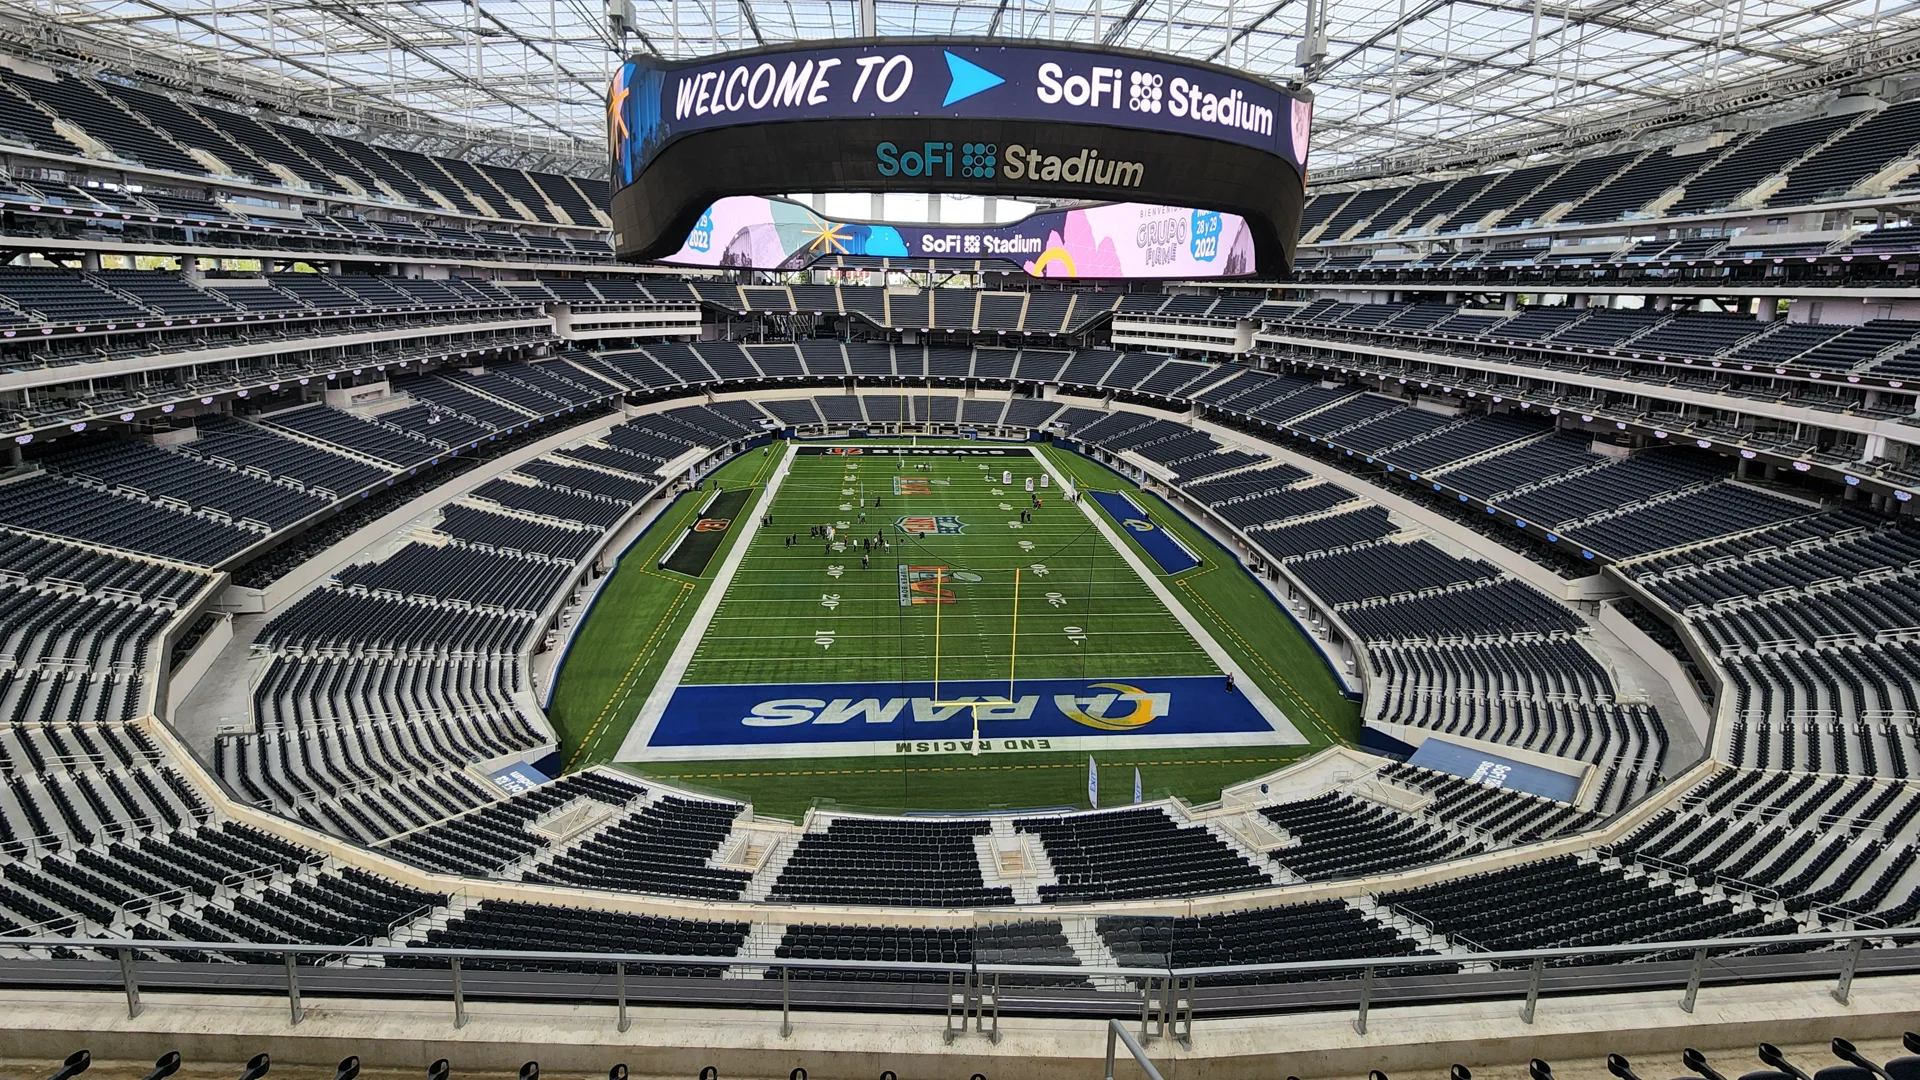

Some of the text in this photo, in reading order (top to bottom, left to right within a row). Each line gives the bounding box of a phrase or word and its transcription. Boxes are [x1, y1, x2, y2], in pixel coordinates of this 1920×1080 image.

[676, 54, 914, 121] WELCOME TO
[1037, 62, 1273, 136] SoFi Stadium
[876, 142, 1145, 187] SoFi Stadium
[1139, 205, 1183, 218] BIENVENI
[1137, 217, 1187, 248] GRUPO
[1196, 220, 1205, 234] 28
[1209, 216, 1218, 232] 29
[922, 235, 1042, 254] SoFi Stadium
[1194, 236, 1216, 258] 2022
[821, 594, 841, 607] 20
[1045, 592, 1067, 605] 20
[814, 630, 836, 645] 10
[1063, 626, 1088, 642] 10
[741, 695, 1040, 726] RAMS
[896, 739, 1052, 753] END RACISM
